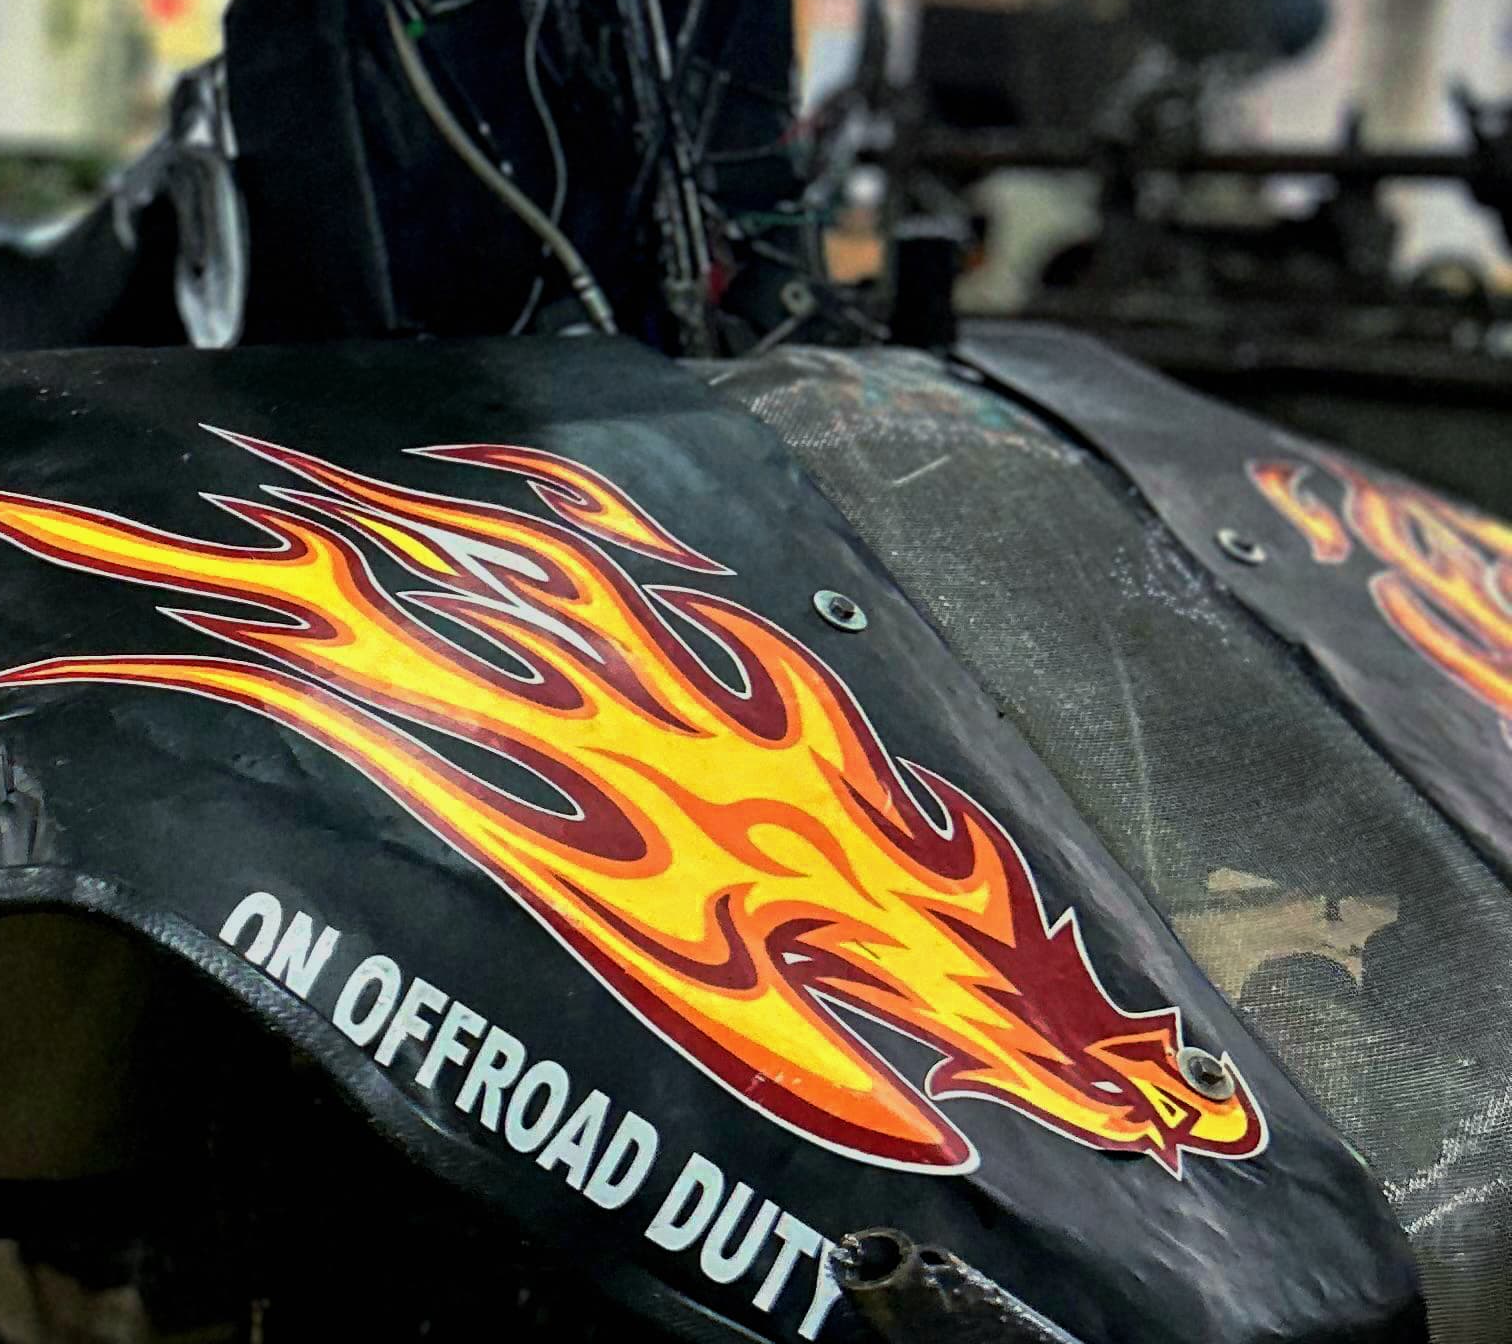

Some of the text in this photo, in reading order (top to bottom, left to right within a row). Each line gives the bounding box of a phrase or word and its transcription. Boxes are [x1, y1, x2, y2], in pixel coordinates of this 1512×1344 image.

[219, 892, 842, 1341] ON OFFROAD DUTY
